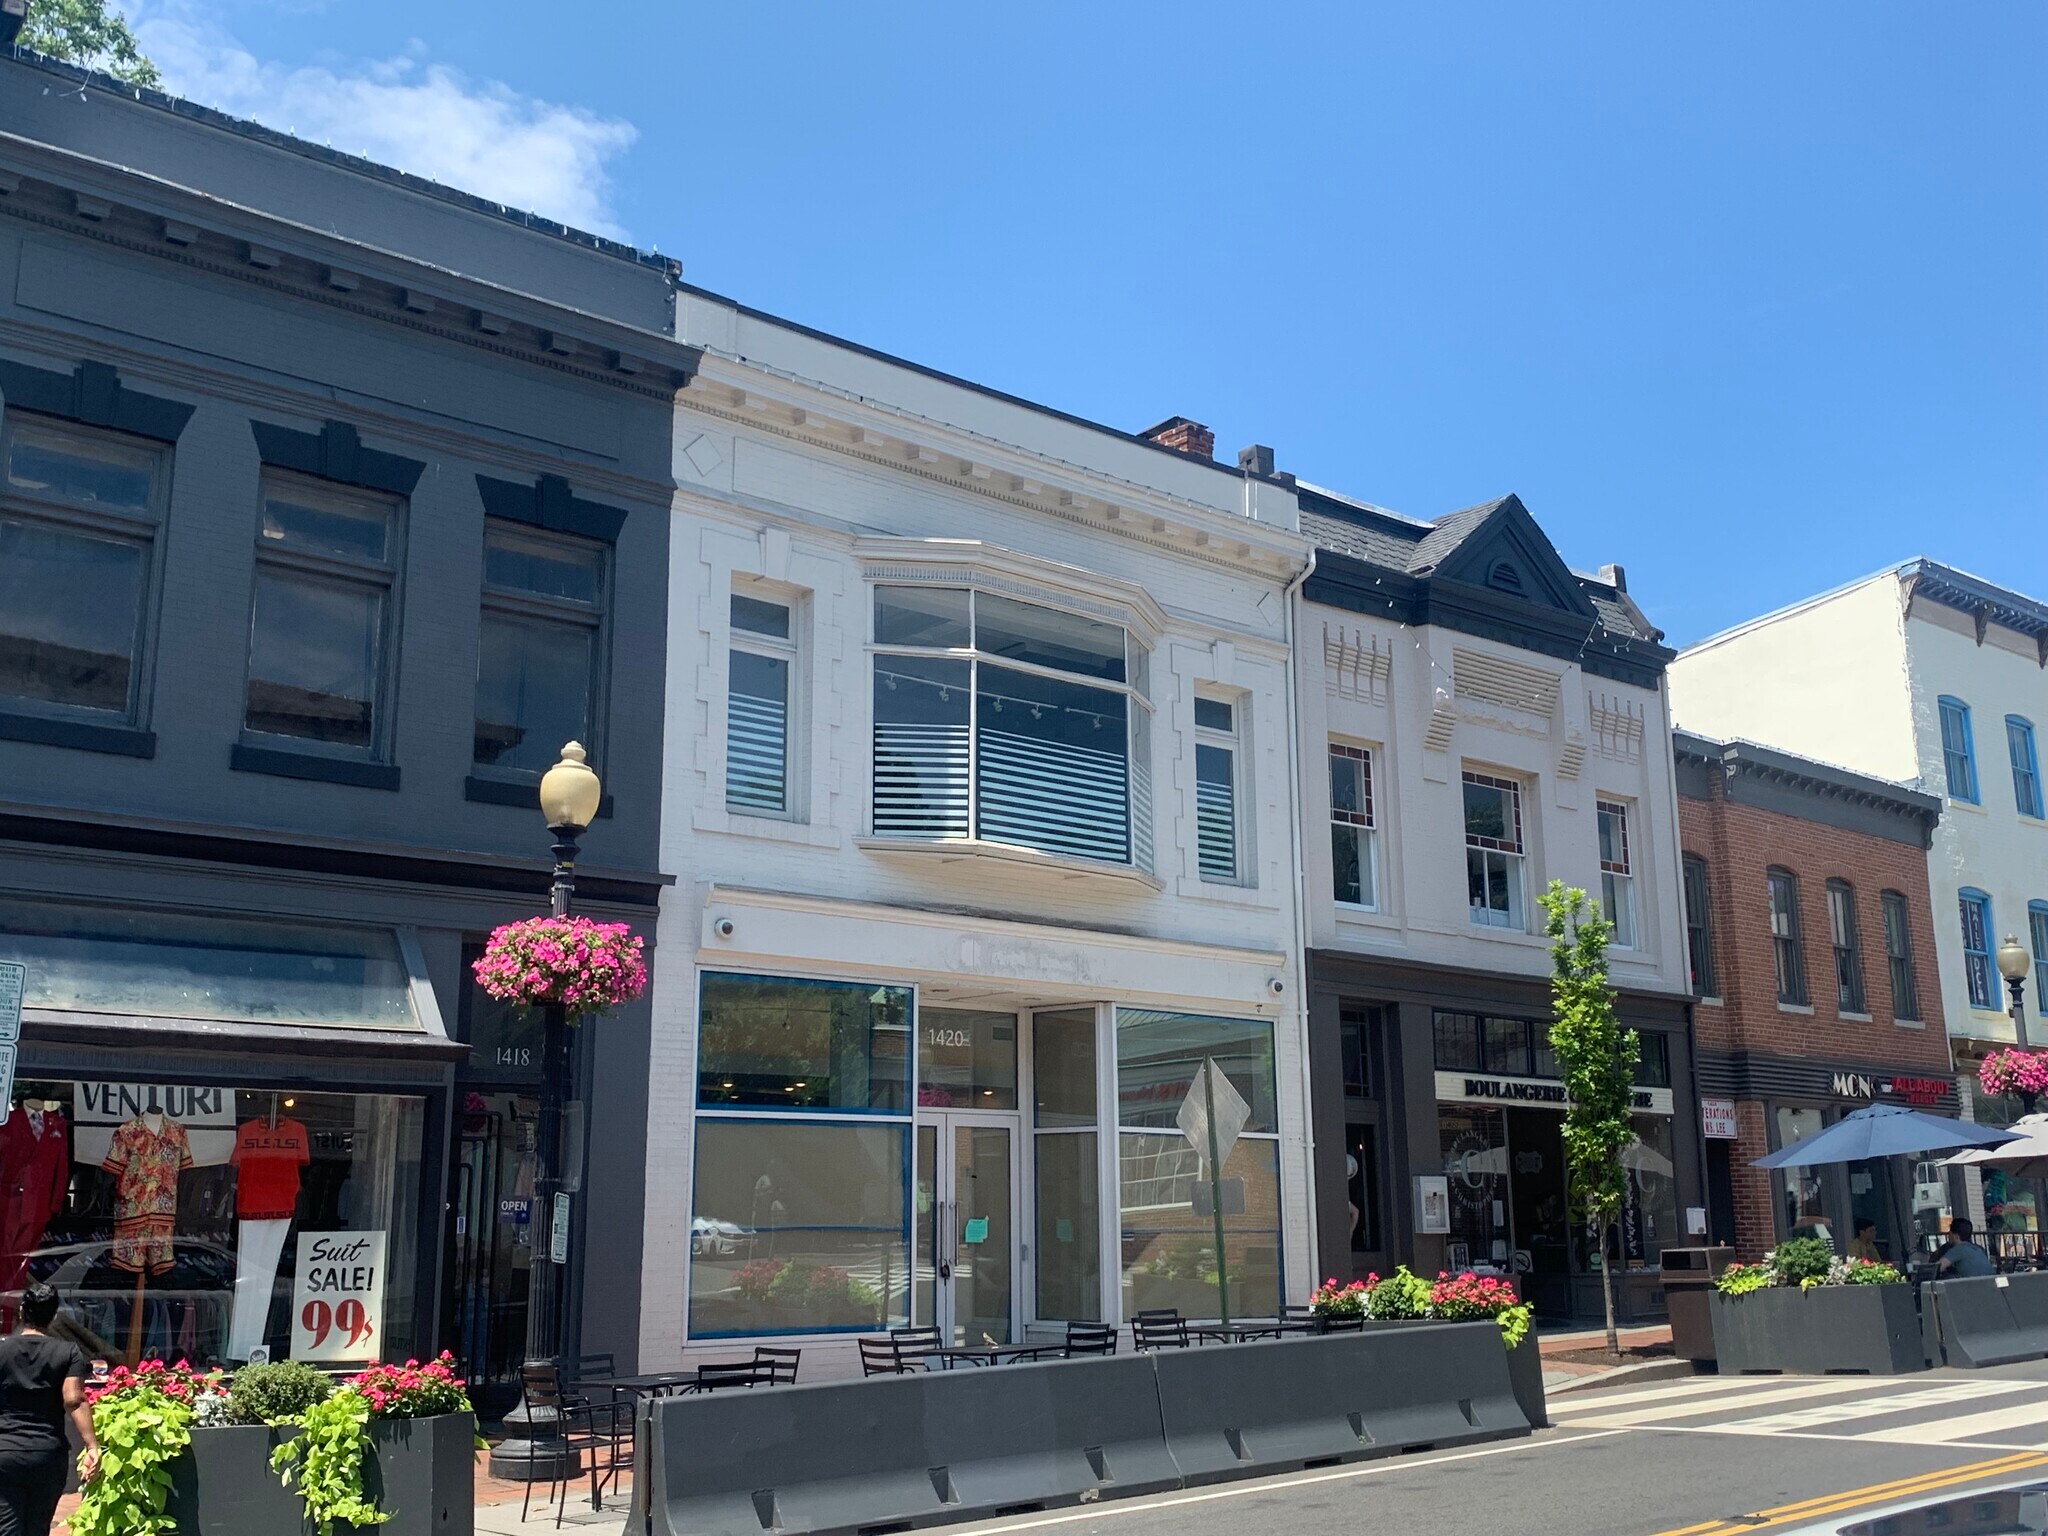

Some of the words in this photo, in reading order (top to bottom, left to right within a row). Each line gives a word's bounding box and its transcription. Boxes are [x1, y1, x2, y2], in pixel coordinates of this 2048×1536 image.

[929, 1028, 964, 1047] 1420
[496, 1047, 530, 1067] 1418
[1464, 1079, 1567, 1103] BOULANGERIE
[501, 1201, 528, 1211] OPEN
[309, 1238, 371, 1262] Suit
[307, 1267, 375, 1292] SALE!
